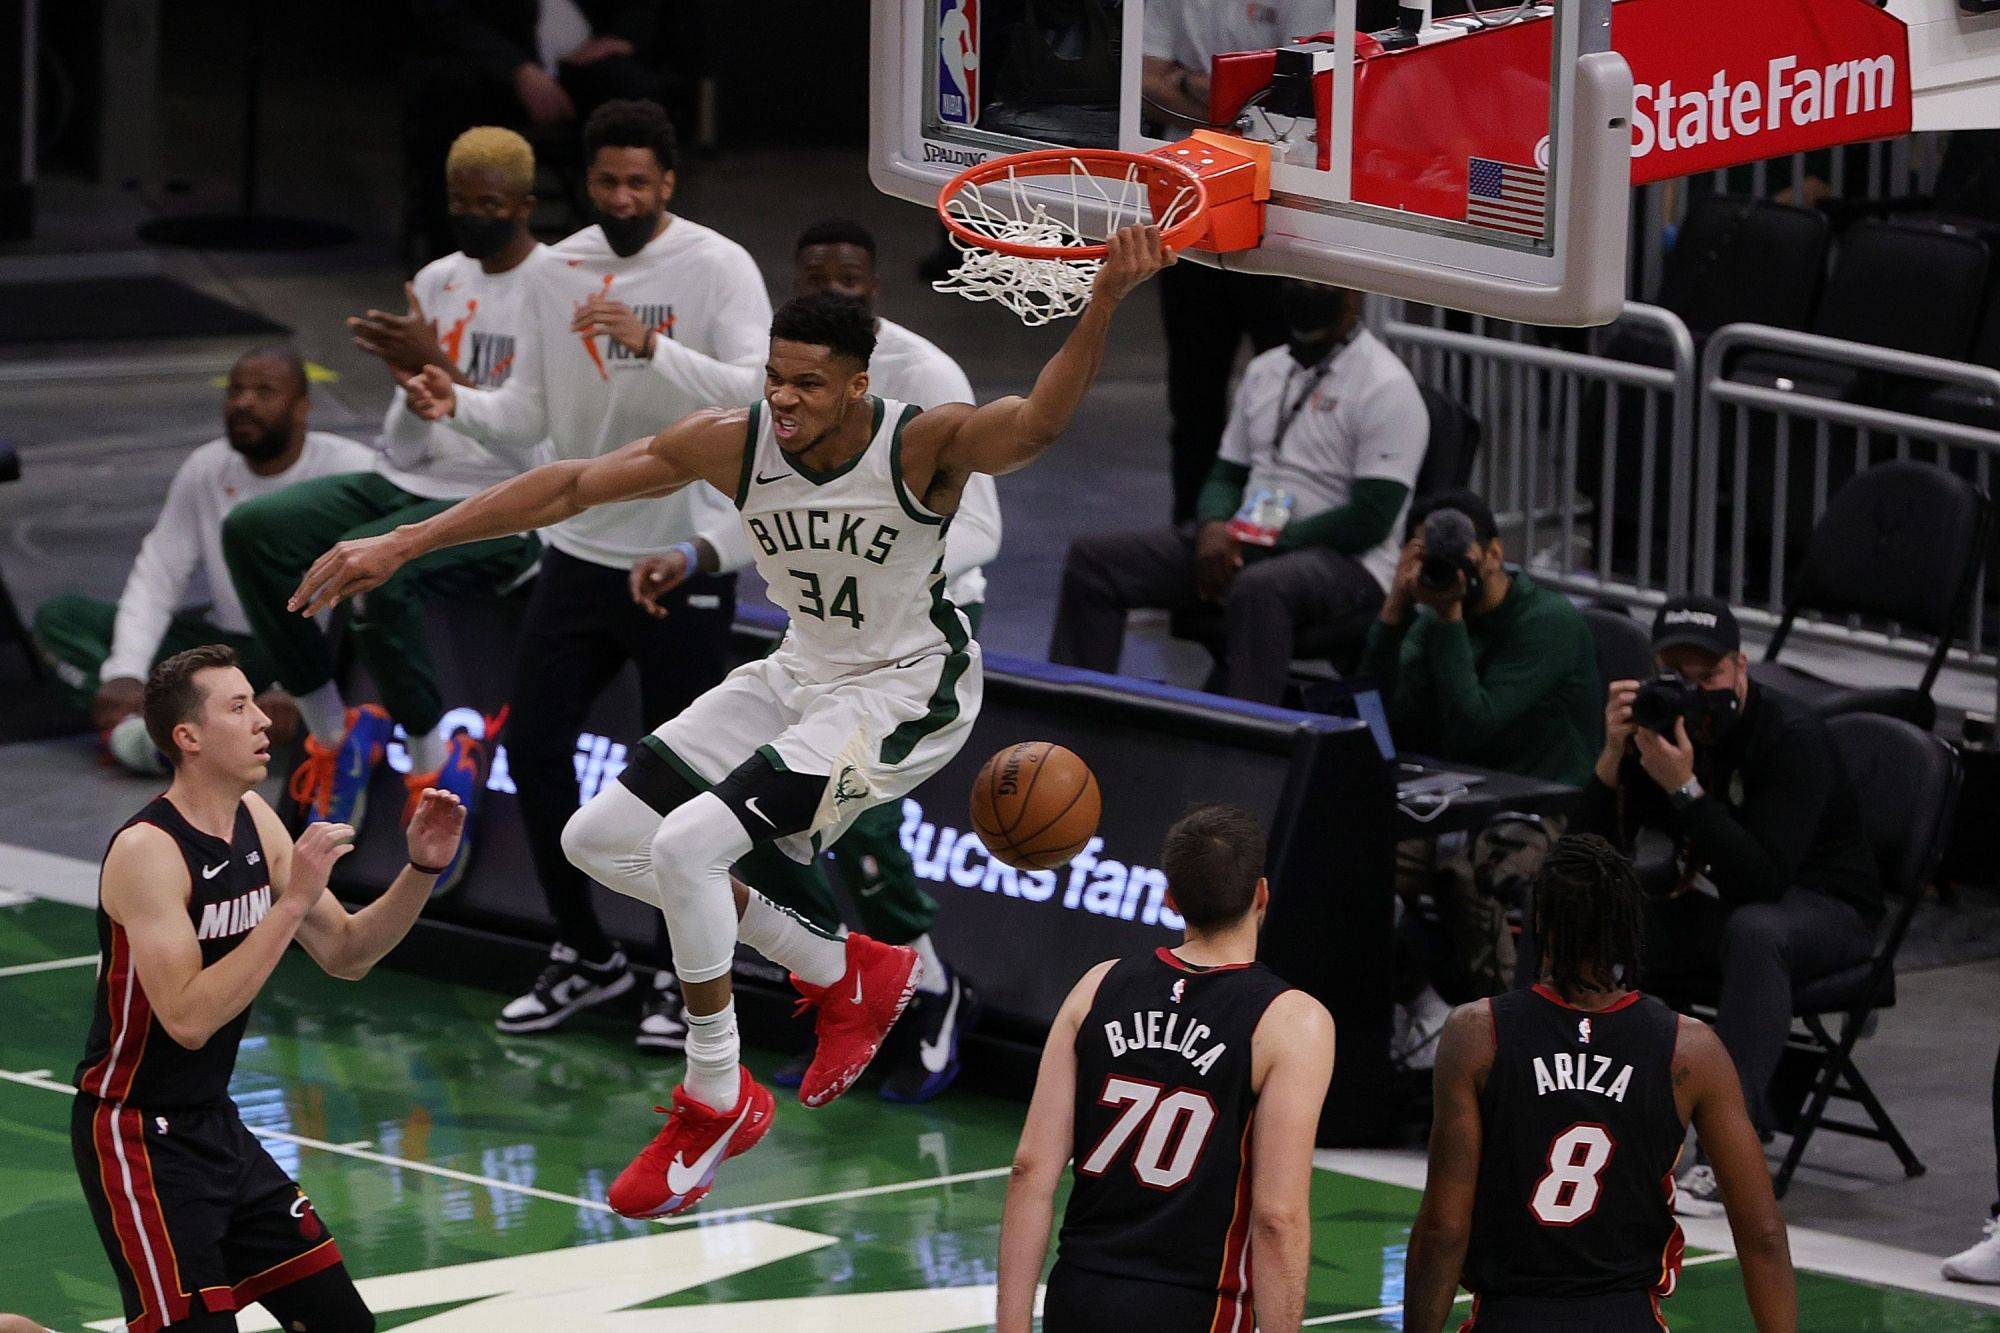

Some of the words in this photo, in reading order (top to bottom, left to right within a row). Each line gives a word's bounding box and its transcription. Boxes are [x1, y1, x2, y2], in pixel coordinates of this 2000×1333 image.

[923, 142, 987, 168] SPALDING
[748, 510, 900, 565] BUCKS
[787, 568, 865, 630] 34
[198, 885, 272, 939] MIAMI
[1104, 1010, 1227, 1076] BJELICA
[1532, 1052, 1634, 1103] ARIZA
[1079, 1075, 1218, 1190] 70
[1529, 1122, 1615, 1226] 8
